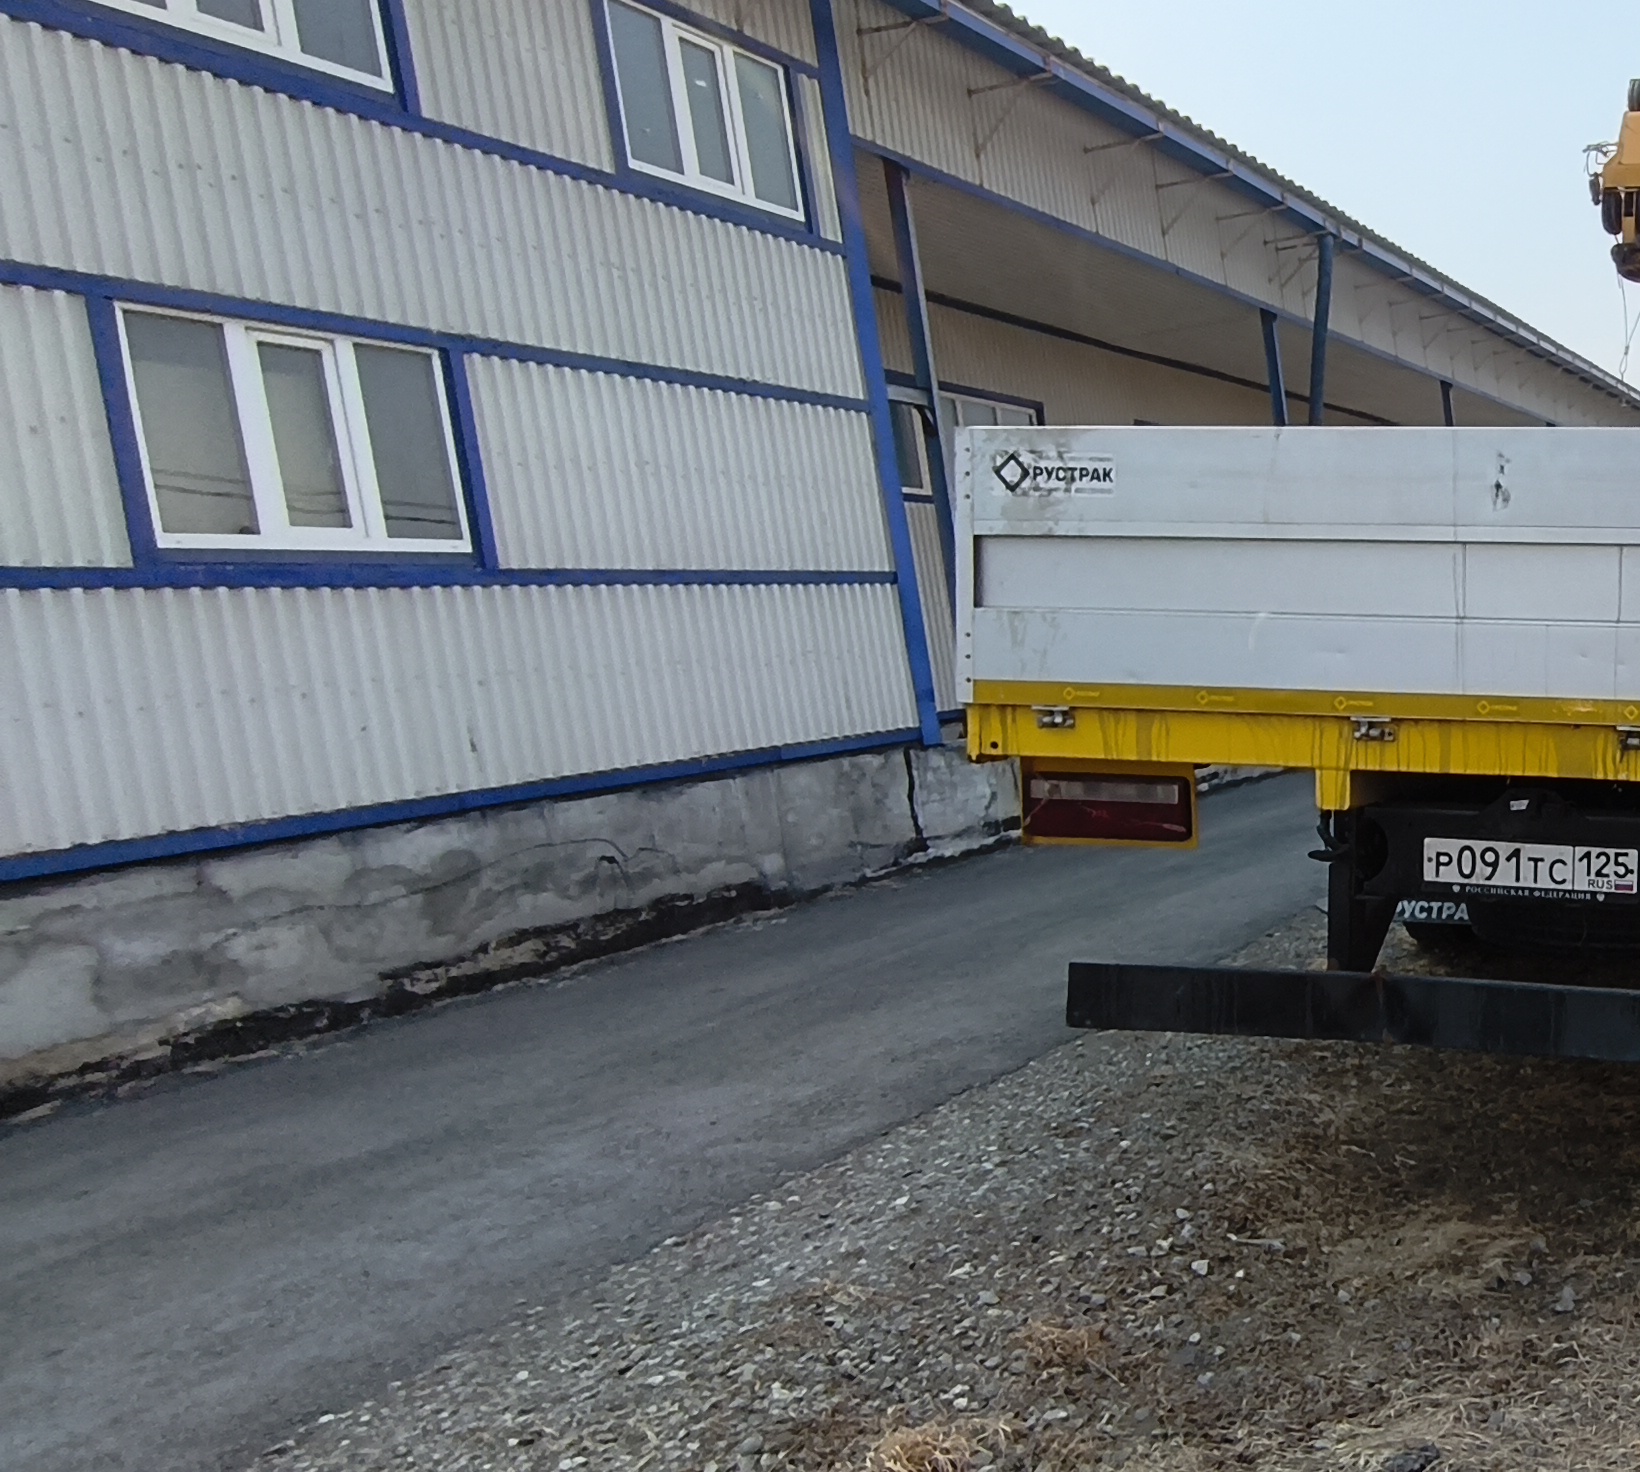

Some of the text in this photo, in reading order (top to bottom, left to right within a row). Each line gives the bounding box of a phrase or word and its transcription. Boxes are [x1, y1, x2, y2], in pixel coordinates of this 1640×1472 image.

[1032, 465, 1114, 483] РУСТРАК
[1434, 845, 1631, 885] Р091ТС 125
[1465, 885, 1592, 901] РОССИЙСКАЯ ФЕДЕРАЦИЯ
[1587, 878, 1613, 891] RUS
